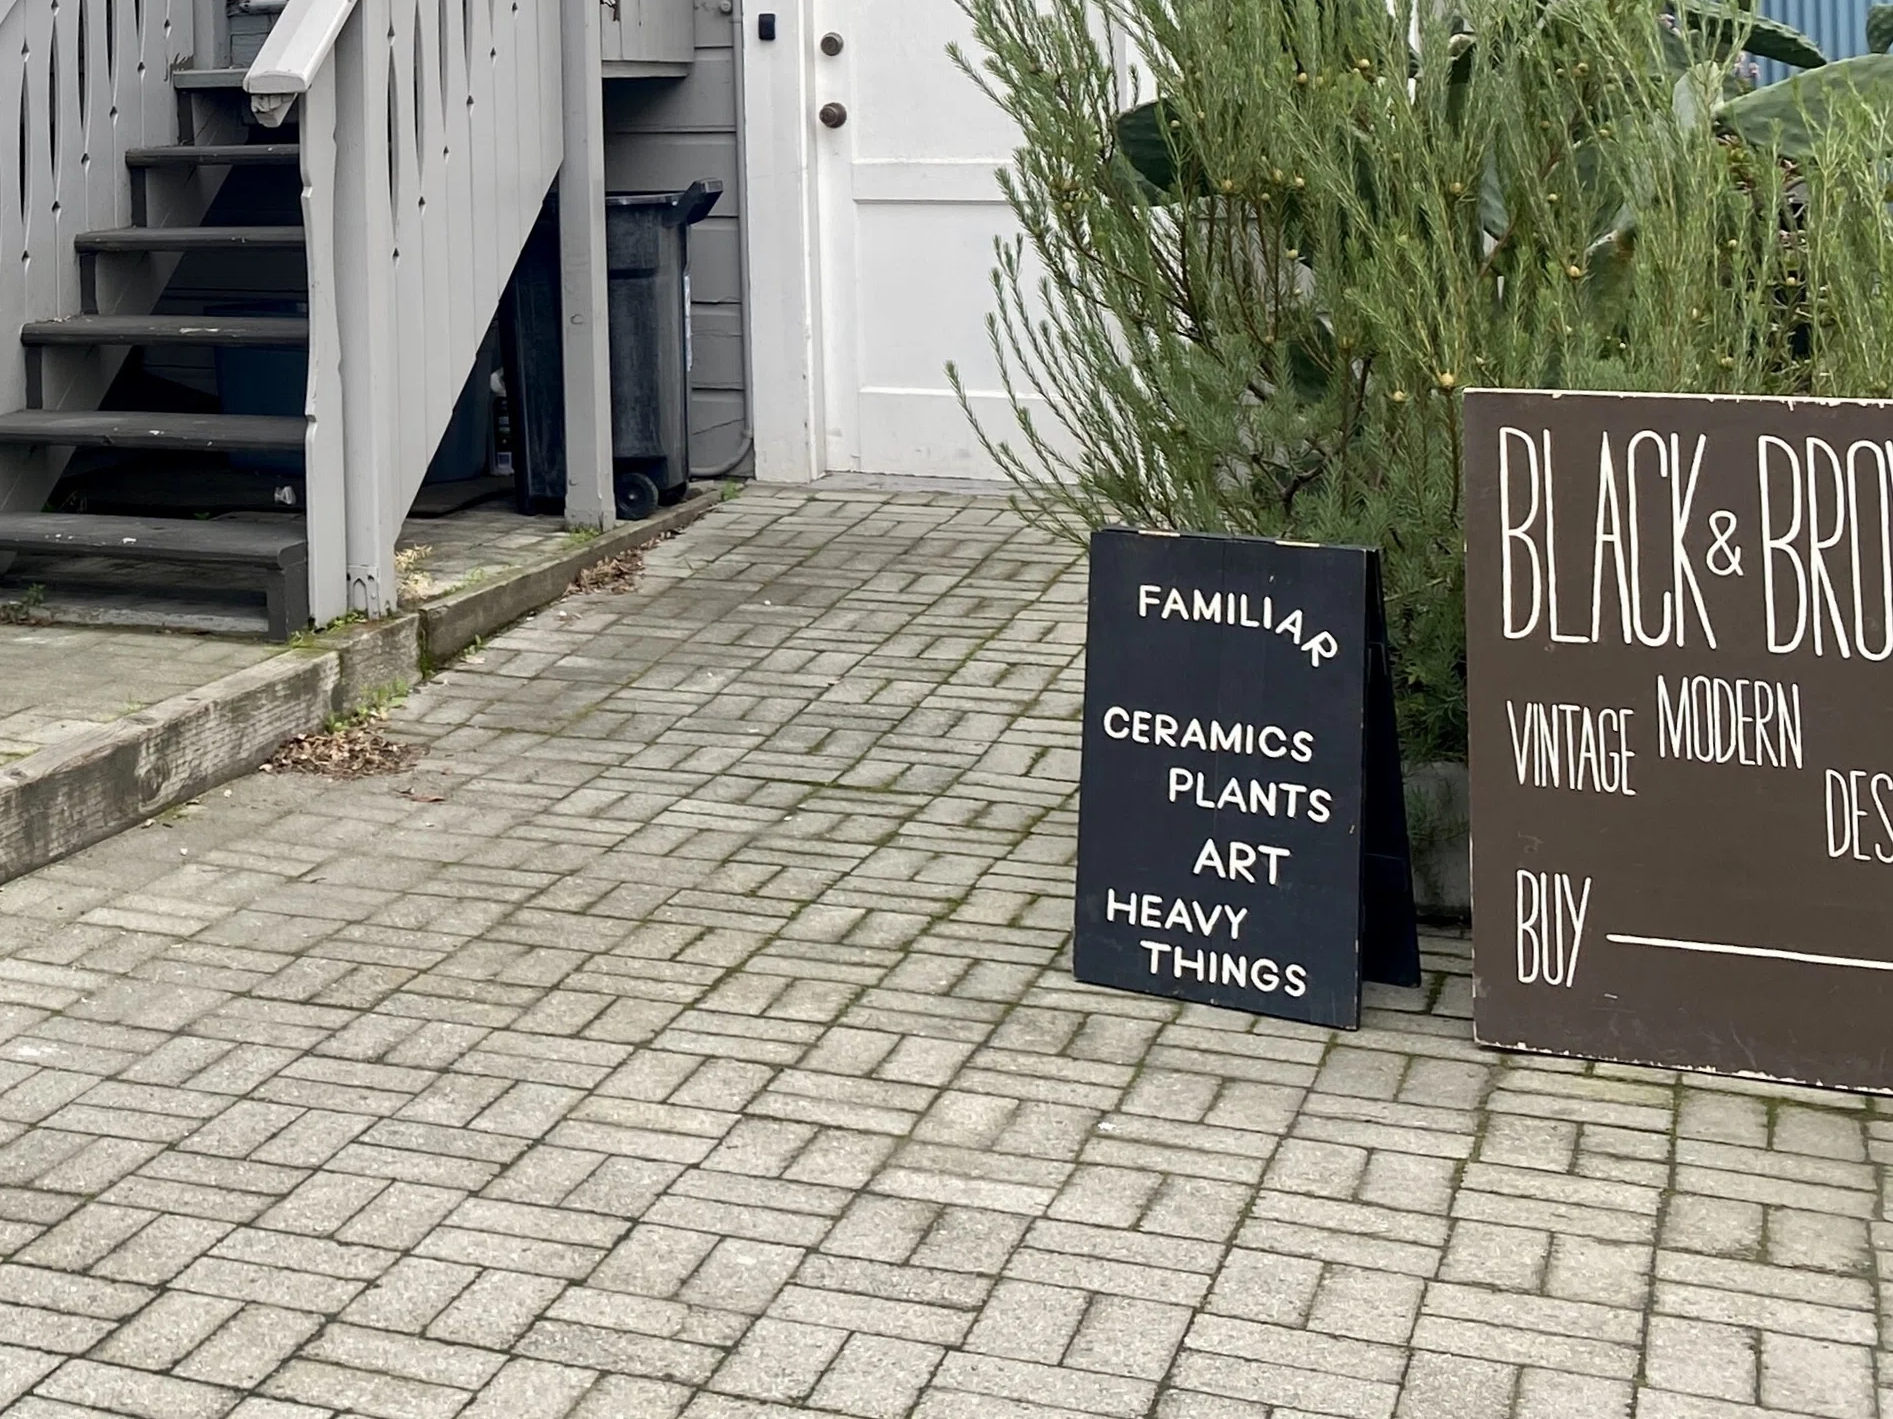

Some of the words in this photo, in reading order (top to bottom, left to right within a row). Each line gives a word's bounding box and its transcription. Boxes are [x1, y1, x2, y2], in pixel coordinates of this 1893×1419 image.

[1499, 427, 1717, 650] BLACK
[1705, 509, 1745, 577] &
[1758, 434, 1893, 662] BRO
[1138, 584, 1339, 668] FAMILIAR
[1103, 706, 1315, 764] CERAMICS
[1168, 767, 1334, 824] PLANTS
[1506, 699, 1637, 796] VINTAGE
[1657, 674, 1804, 770] MODERN
[1825, 768, 1893, 864] DES
[1192, 838, 1291, 885] ART
[1106, 887, 1249, 941] HEAVY
[1516, 868, 1593, 989] BUY
[1139, 940, 1308, 998] THINGS
